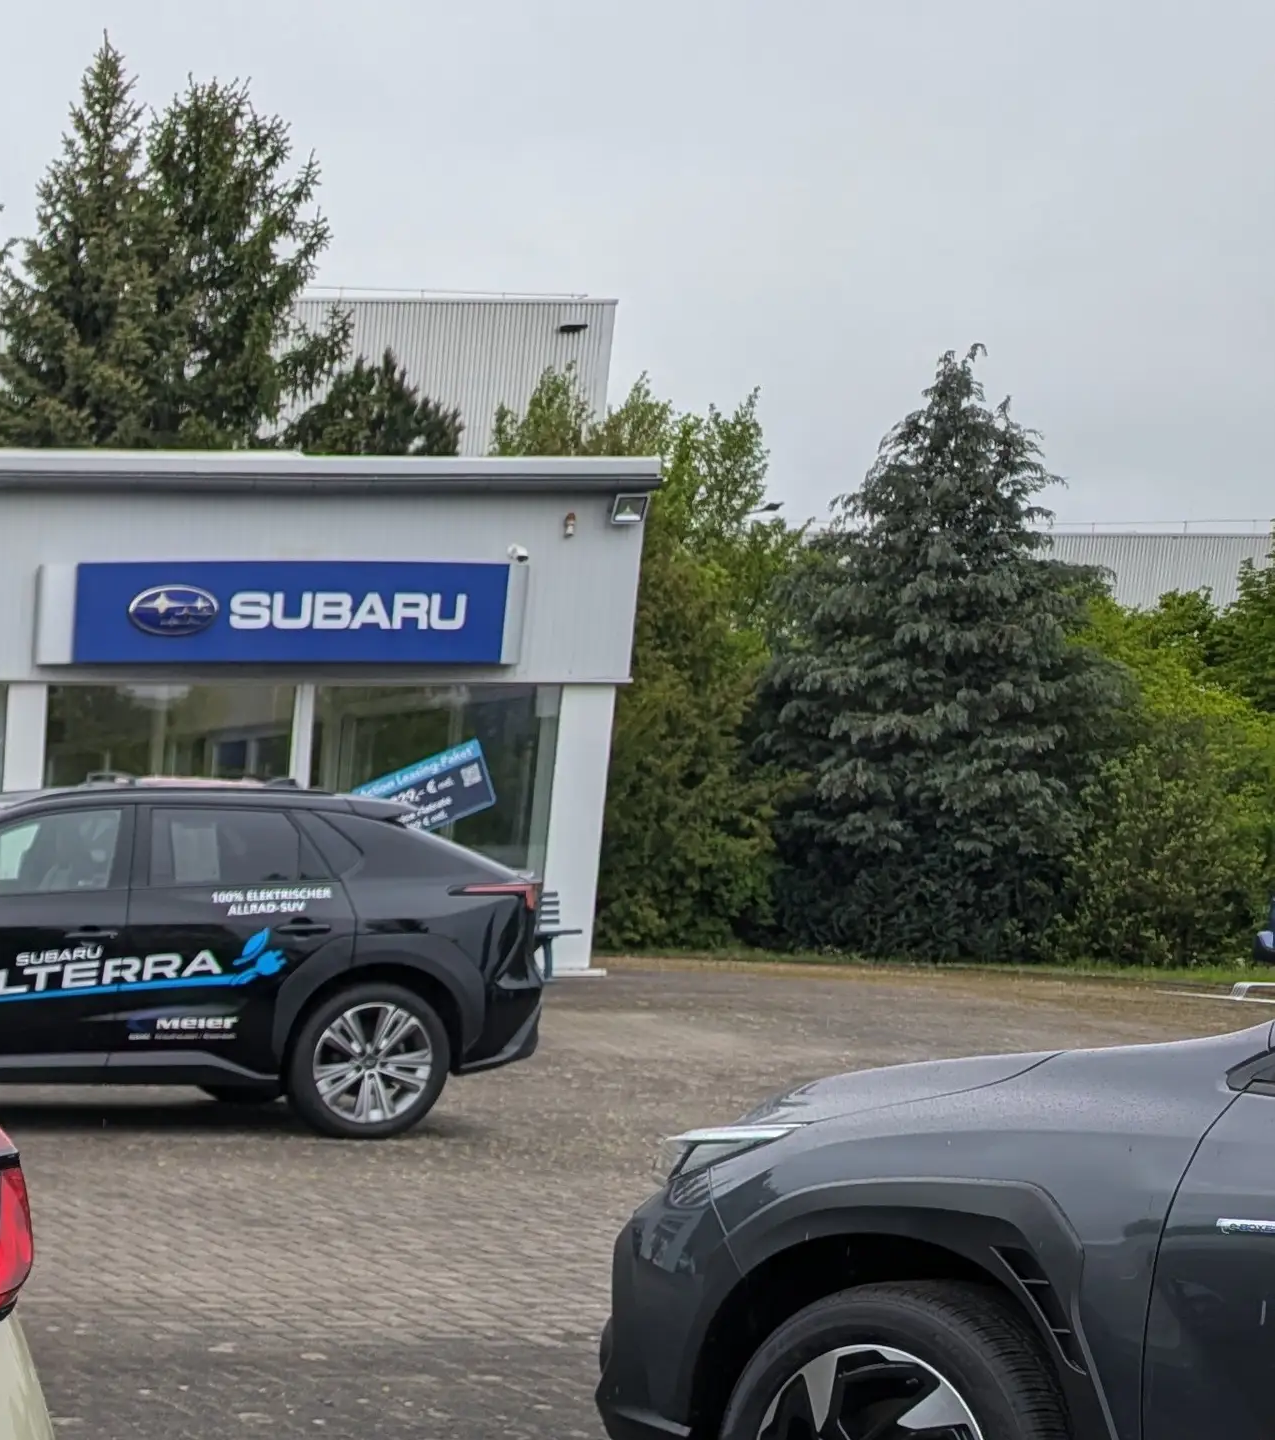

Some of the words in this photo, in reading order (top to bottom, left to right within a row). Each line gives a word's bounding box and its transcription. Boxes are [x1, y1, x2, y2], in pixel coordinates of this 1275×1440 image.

[230, 591, 468, 631] SUBARU
[211, 889, 244, 903] 100%
[246, 887, 332, 902] ELEKTRISCHER
[227, 901, 307, 916] ALLRAD-SUV
[16, 945, 104, 966] SUBARU
